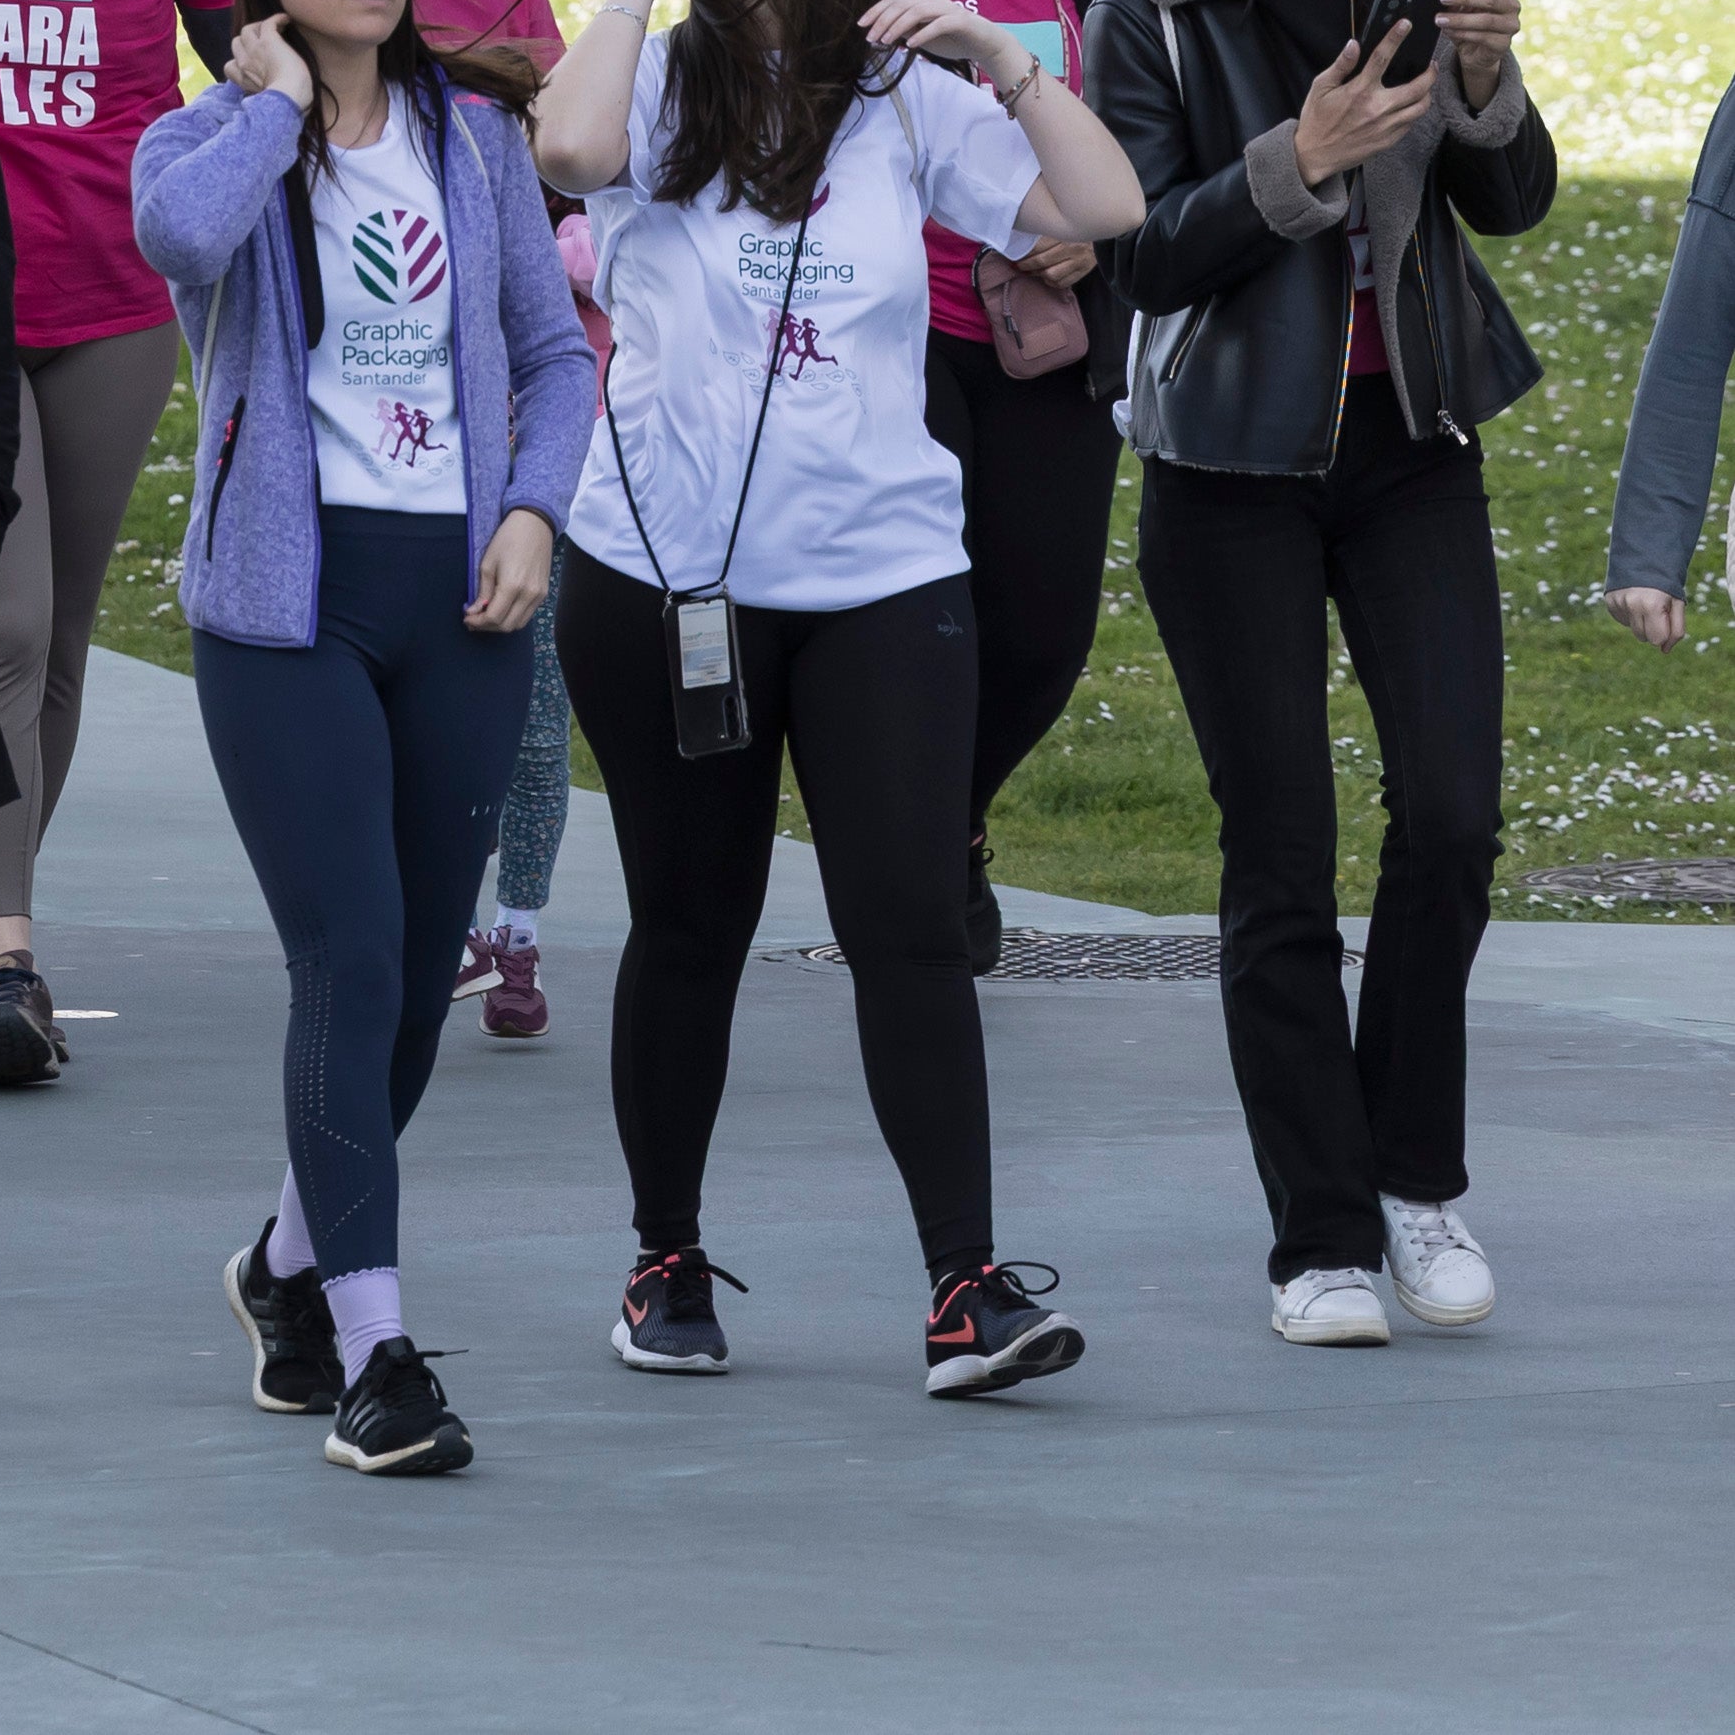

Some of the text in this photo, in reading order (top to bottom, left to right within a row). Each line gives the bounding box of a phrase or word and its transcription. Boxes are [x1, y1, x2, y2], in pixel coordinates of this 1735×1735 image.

[739, 233, 823, 259] Graphic
[739, 258, 854, 284] Packaging
[343, 319, 433, 343] Graphic
[342, 345, 448, 369] Packaging
[342, 371, 426, 385] Santander
